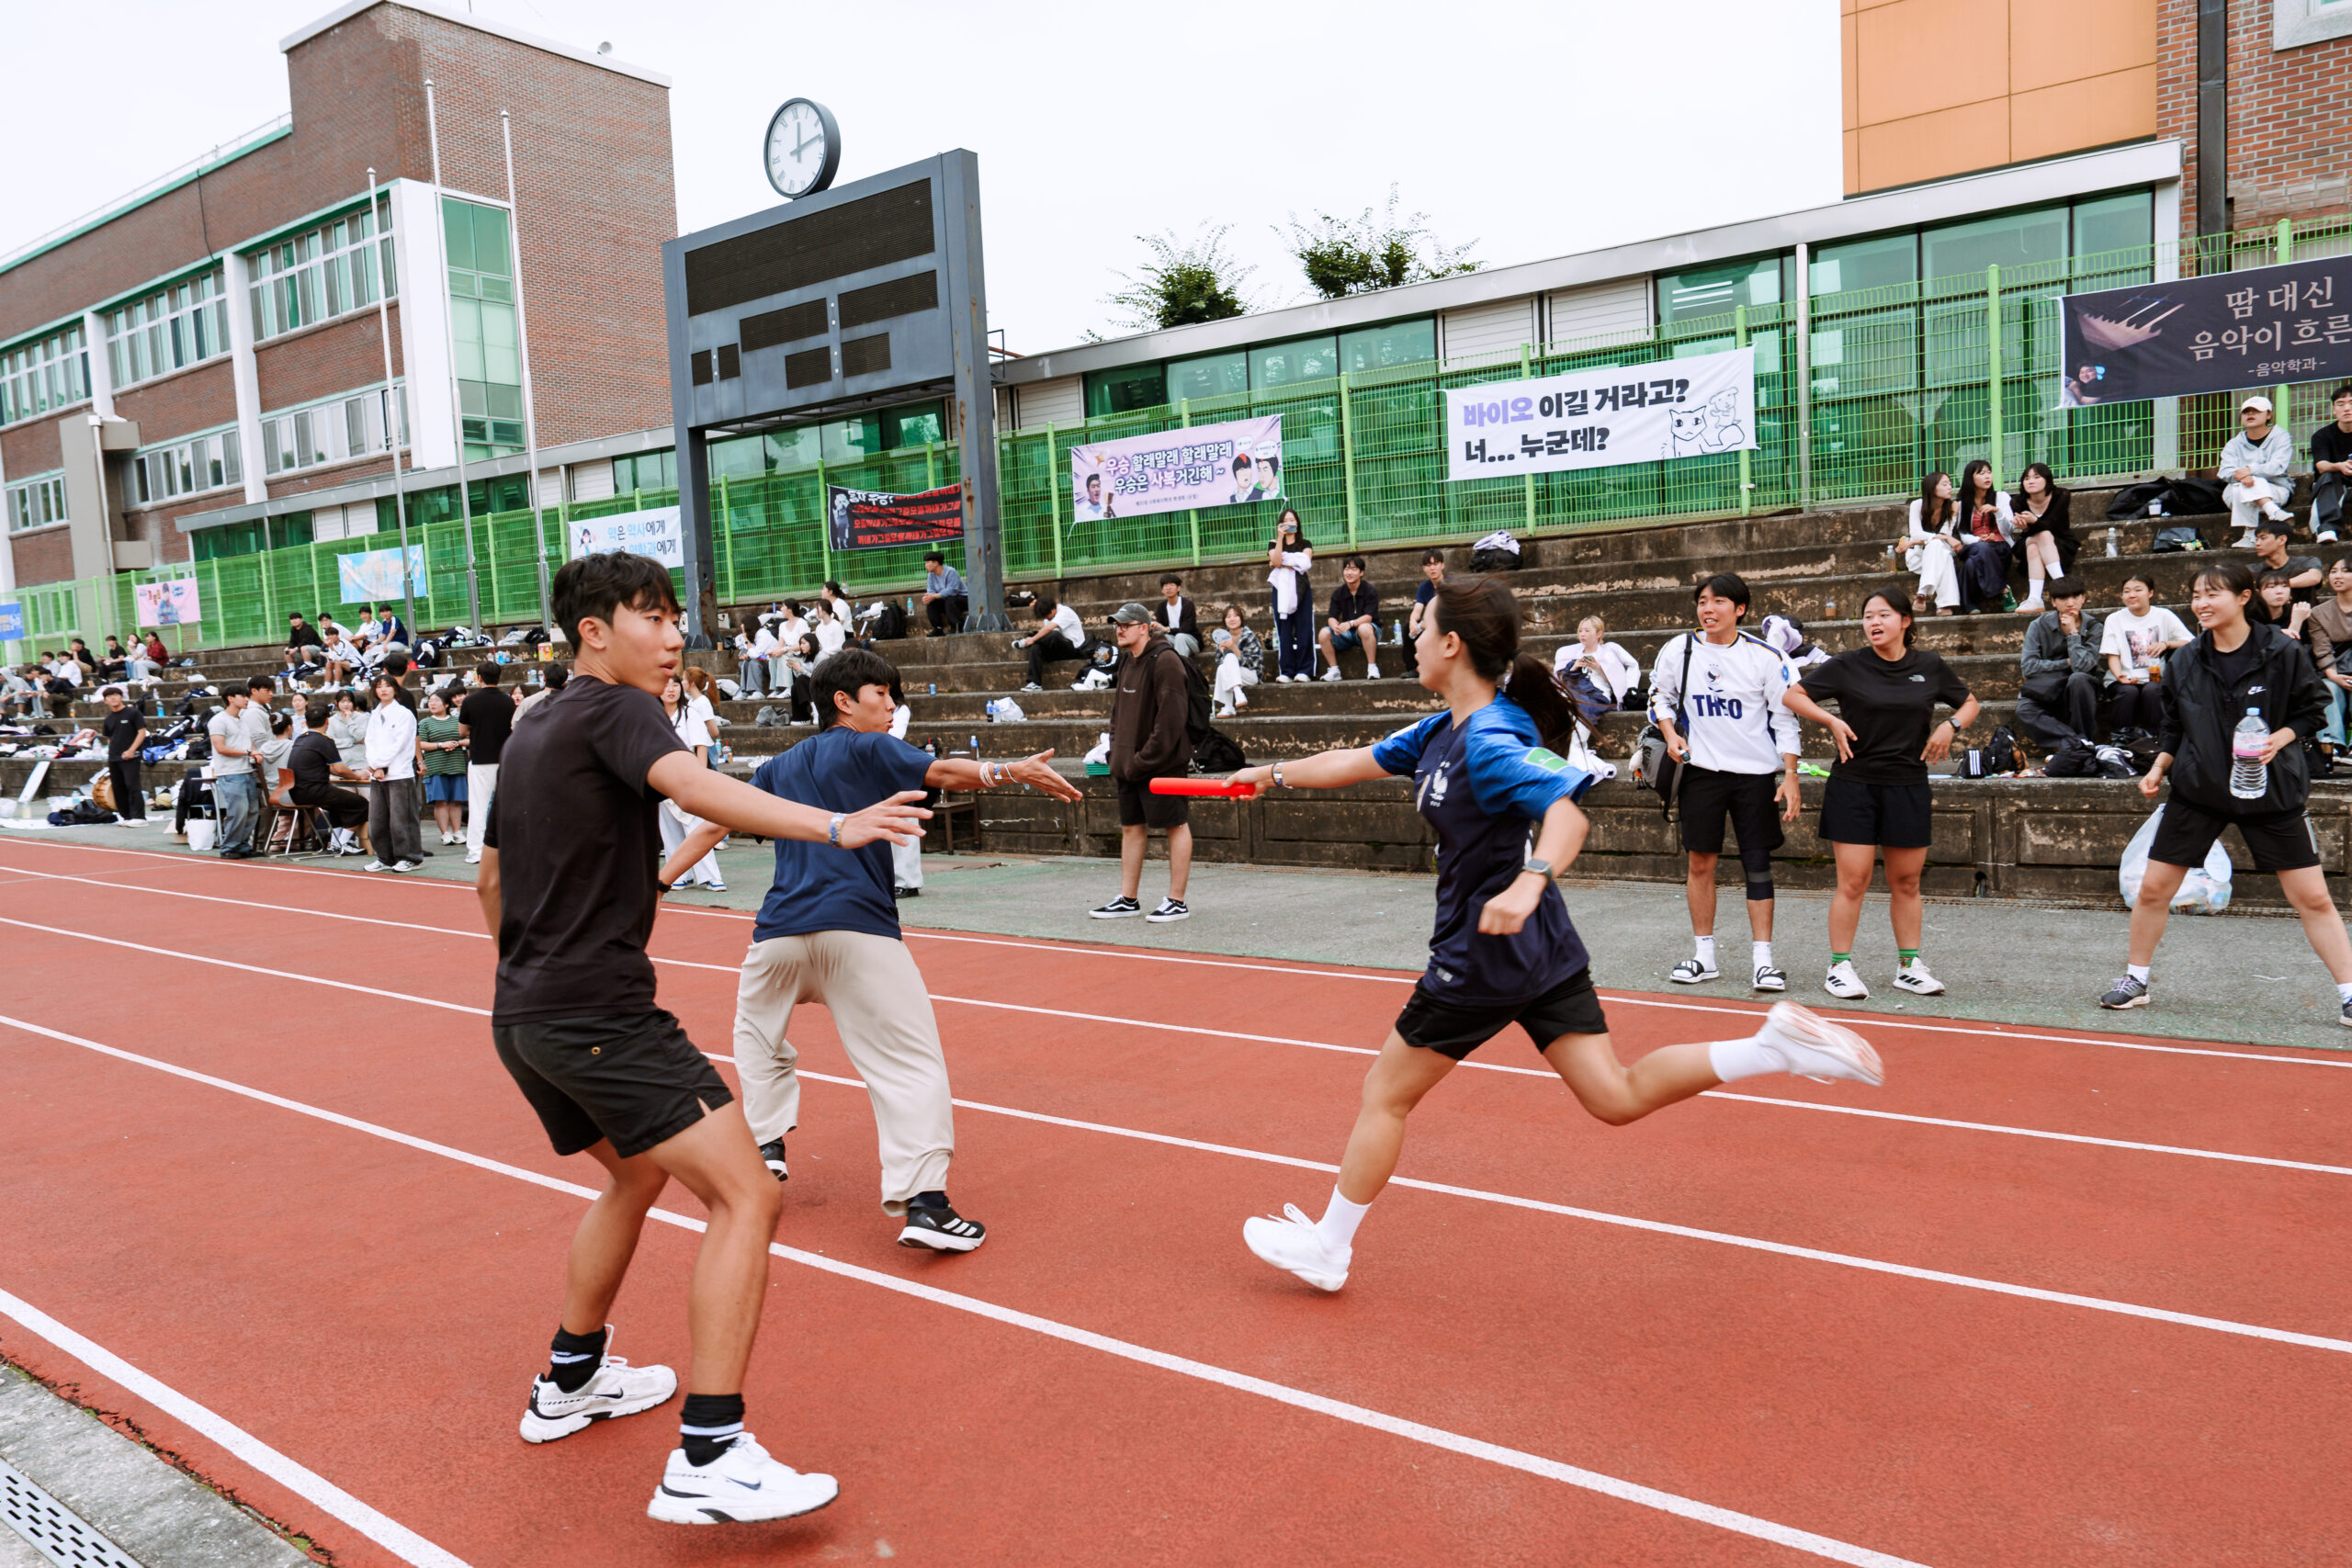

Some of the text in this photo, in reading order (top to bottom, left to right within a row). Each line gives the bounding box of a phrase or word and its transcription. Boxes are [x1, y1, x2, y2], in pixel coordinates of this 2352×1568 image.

[2225, 276, 2334, 320] 땀 대신
[2188, 321, 2282, 361] 음악이
[1463, 378, 1690, 427] 바이오 이길 거라고?
[1105, 457, 1130, 476] 우승
[1132, 448, 1179, 472] 할래말래
[1182, 440, 1233, 466] 할래말래
[1464, 425, 1611, 463] 너... 누군데?
[1114, 474, 1148, 494] 우승은
